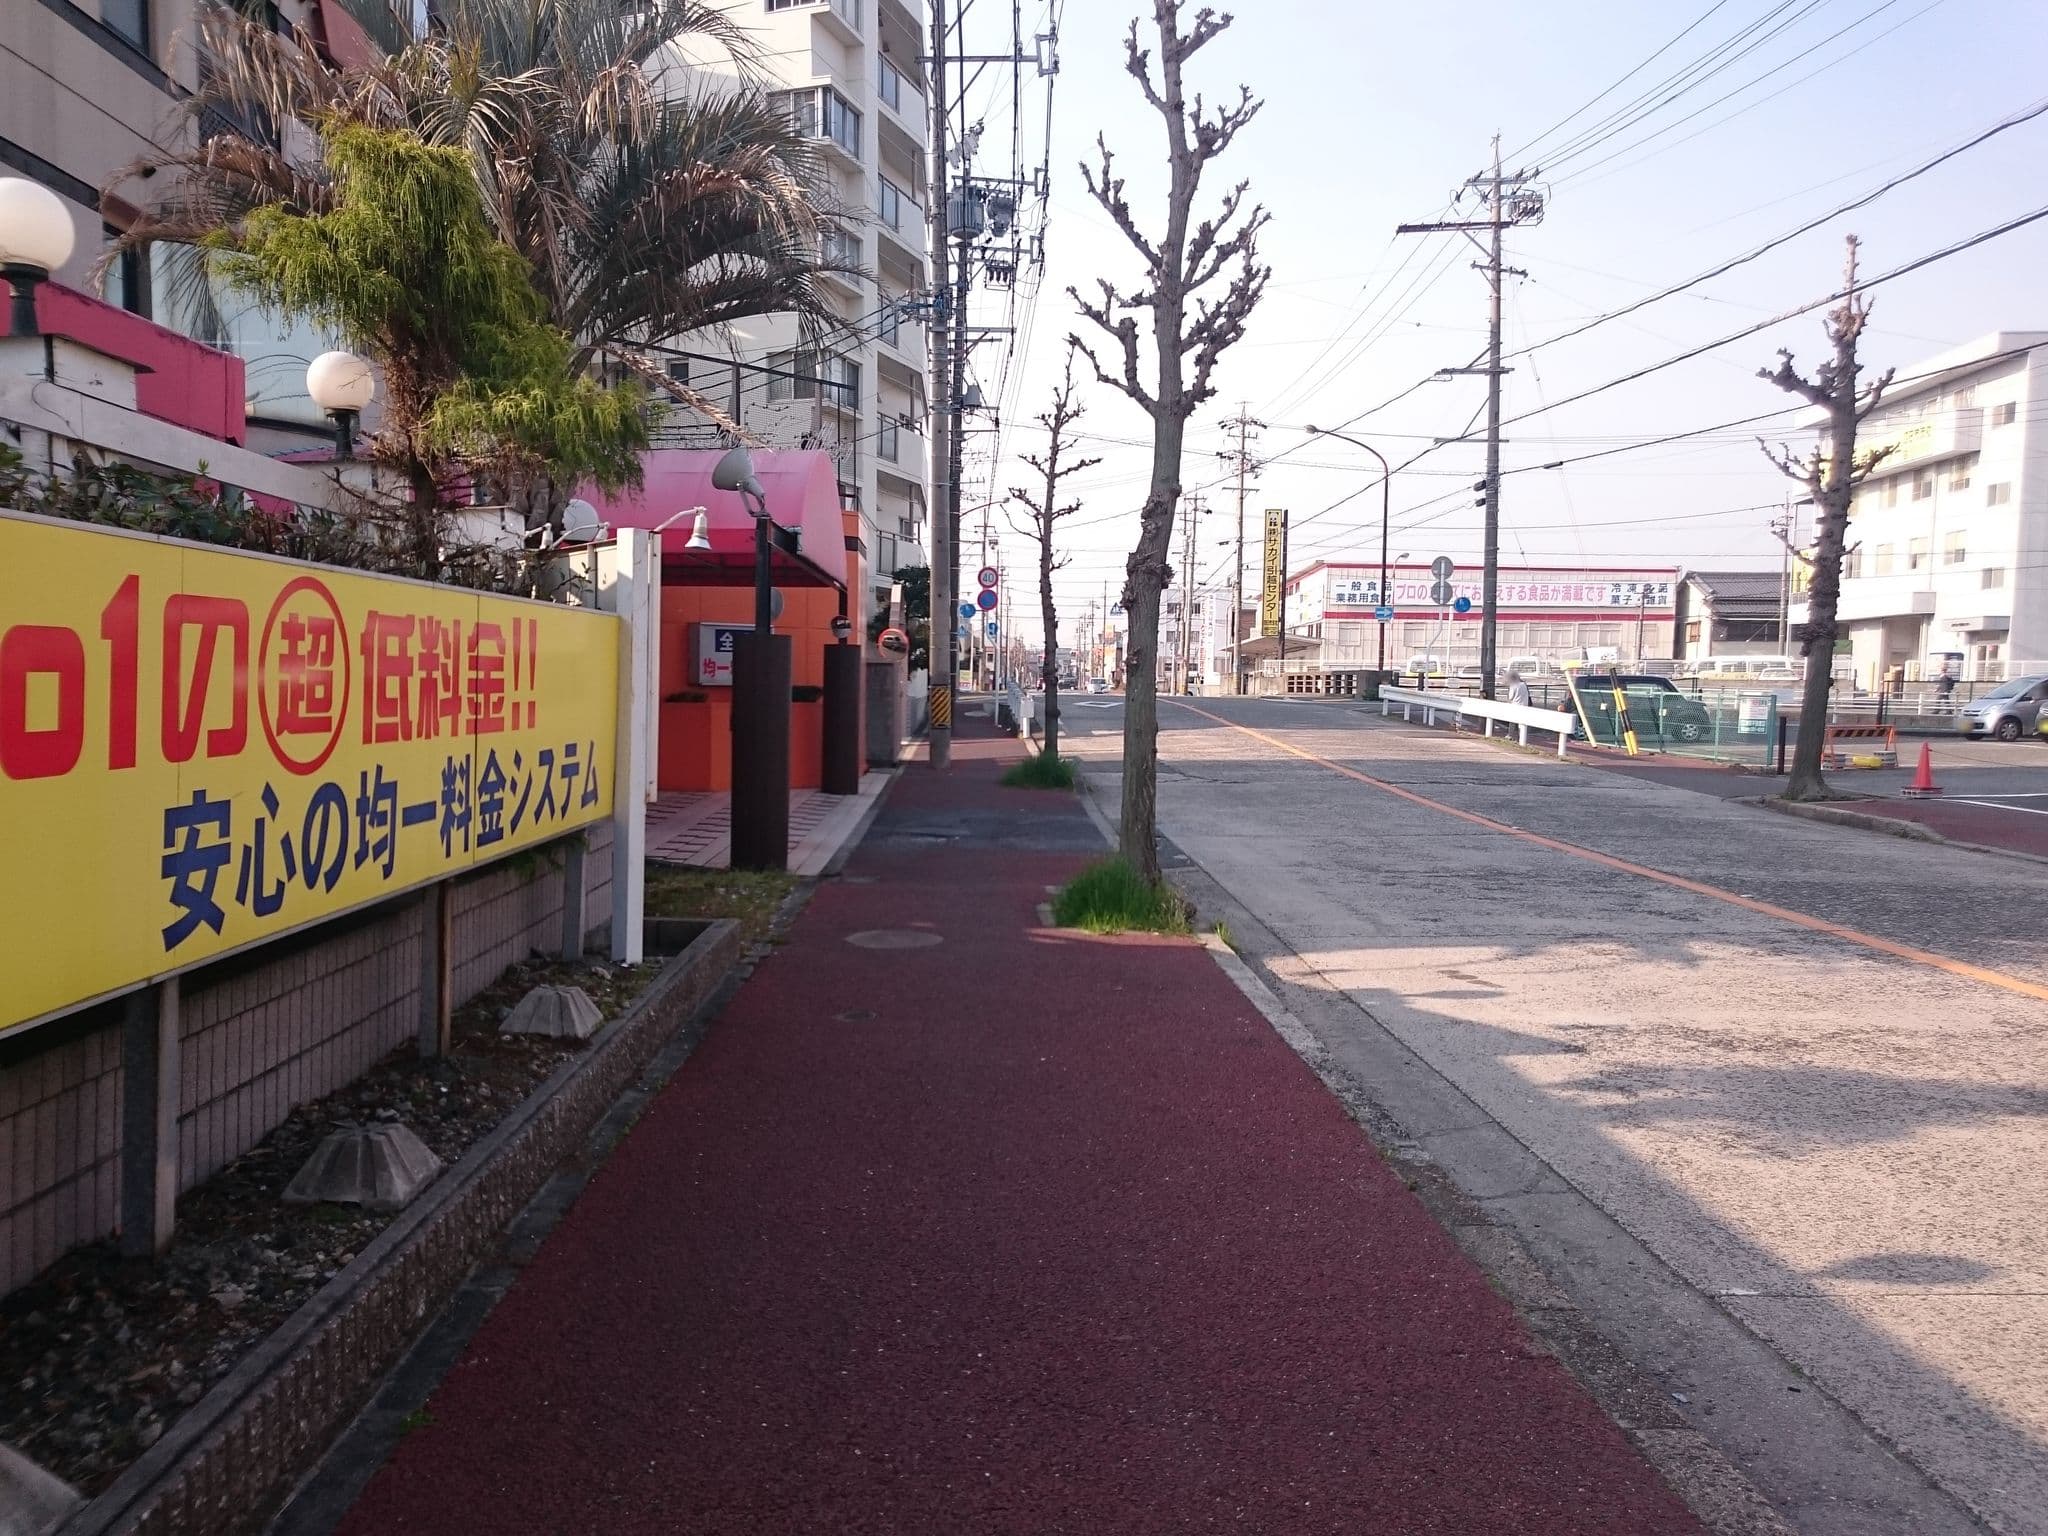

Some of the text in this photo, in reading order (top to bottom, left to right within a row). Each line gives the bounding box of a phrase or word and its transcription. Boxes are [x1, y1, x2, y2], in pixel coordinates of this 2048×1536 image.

[982, 573, 995, 583] 40
[160, 740, 600, 952] 安心の均一料金システム
